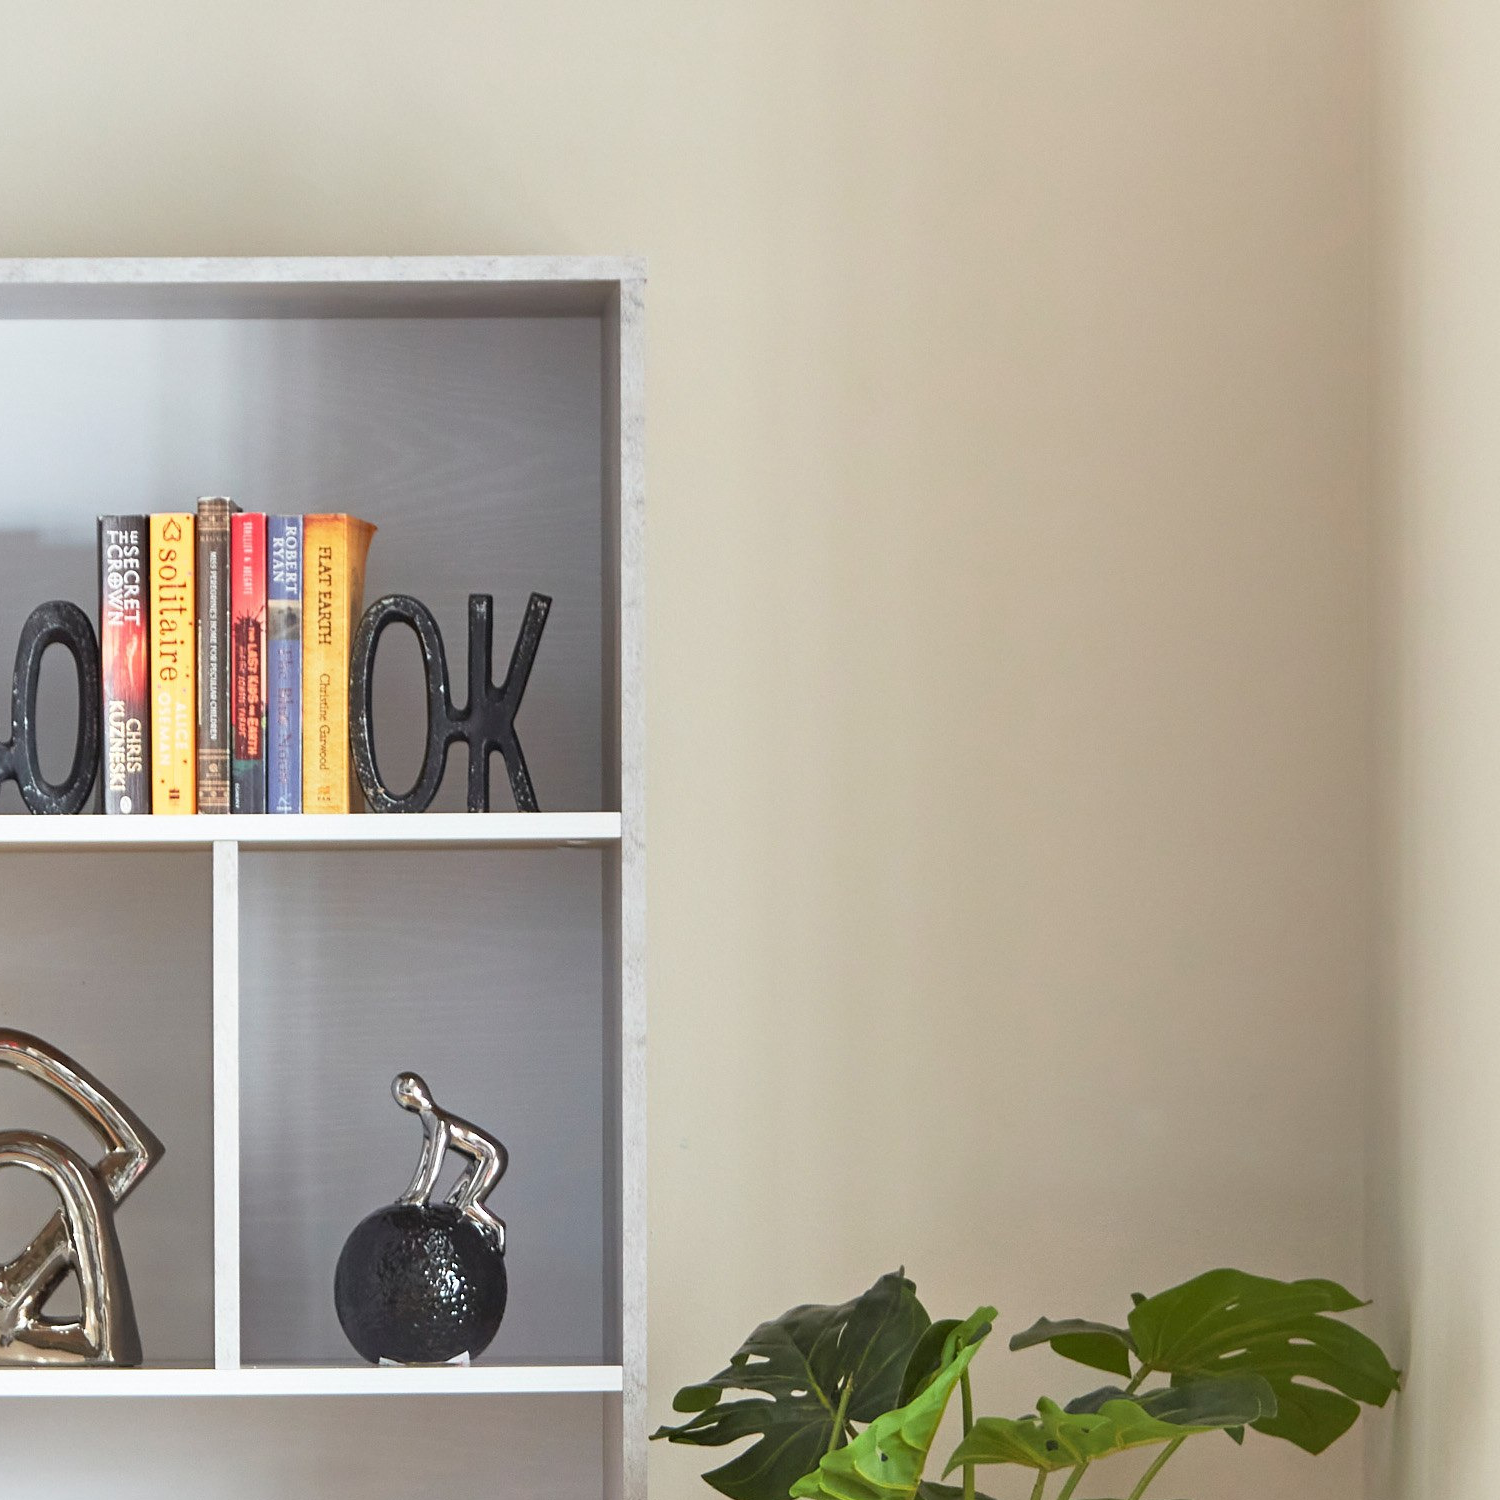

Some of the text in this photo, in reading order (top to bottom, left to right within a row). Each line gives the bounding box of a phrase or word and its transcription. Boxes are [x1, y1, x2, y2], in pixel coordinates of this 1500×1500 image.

[107, 530, 139, 545] THE
[272, 537, 285, 583] RYAN
[284, 525, 298, 594] ROBERT
[106, 544, 124, 626] CROWN
[123, 545, 141, 626] SECRET
[158, 548, 187, 681] solitaire
[317, 546, 332, 645] FLAT EARTH
[209, 620, 218, 643] HOME
[108, 700, 127, 791] KUZNESKI
[125, 718, 142, 774] CHRIS
[157, 691, 172, 766] OSEMAN
[175, 702, 189, 750] ALICE
[209, 700, 218, 740] CHILDREN
[246, 717, 259, 755] EARTH
[318, 673, 331, 771] Christine Garwood
